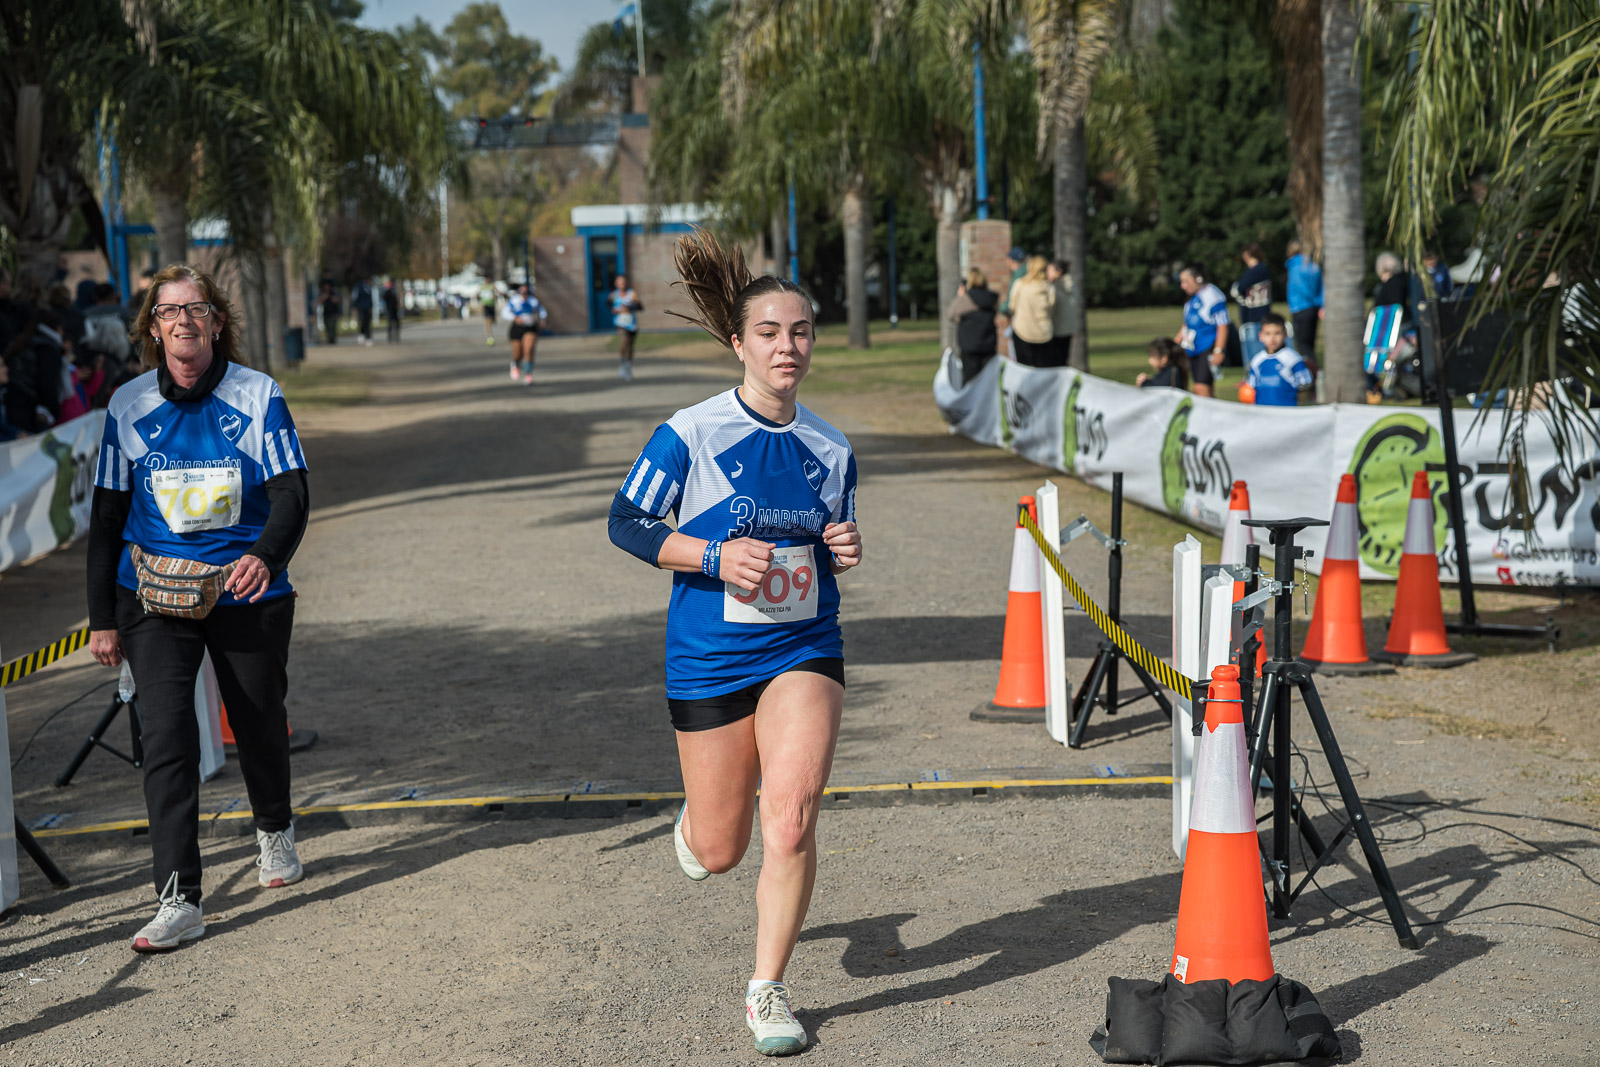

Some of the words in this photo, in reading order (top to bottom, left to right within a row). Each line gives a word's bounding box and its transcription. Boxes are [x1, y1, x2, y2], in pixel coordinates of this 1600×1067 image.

[183, 473, 189, 483] 3
[159, 485, 232, 519] 705
[728, 495, 756, 540] 3
[756, 508, 825, 532] MARATÓN
